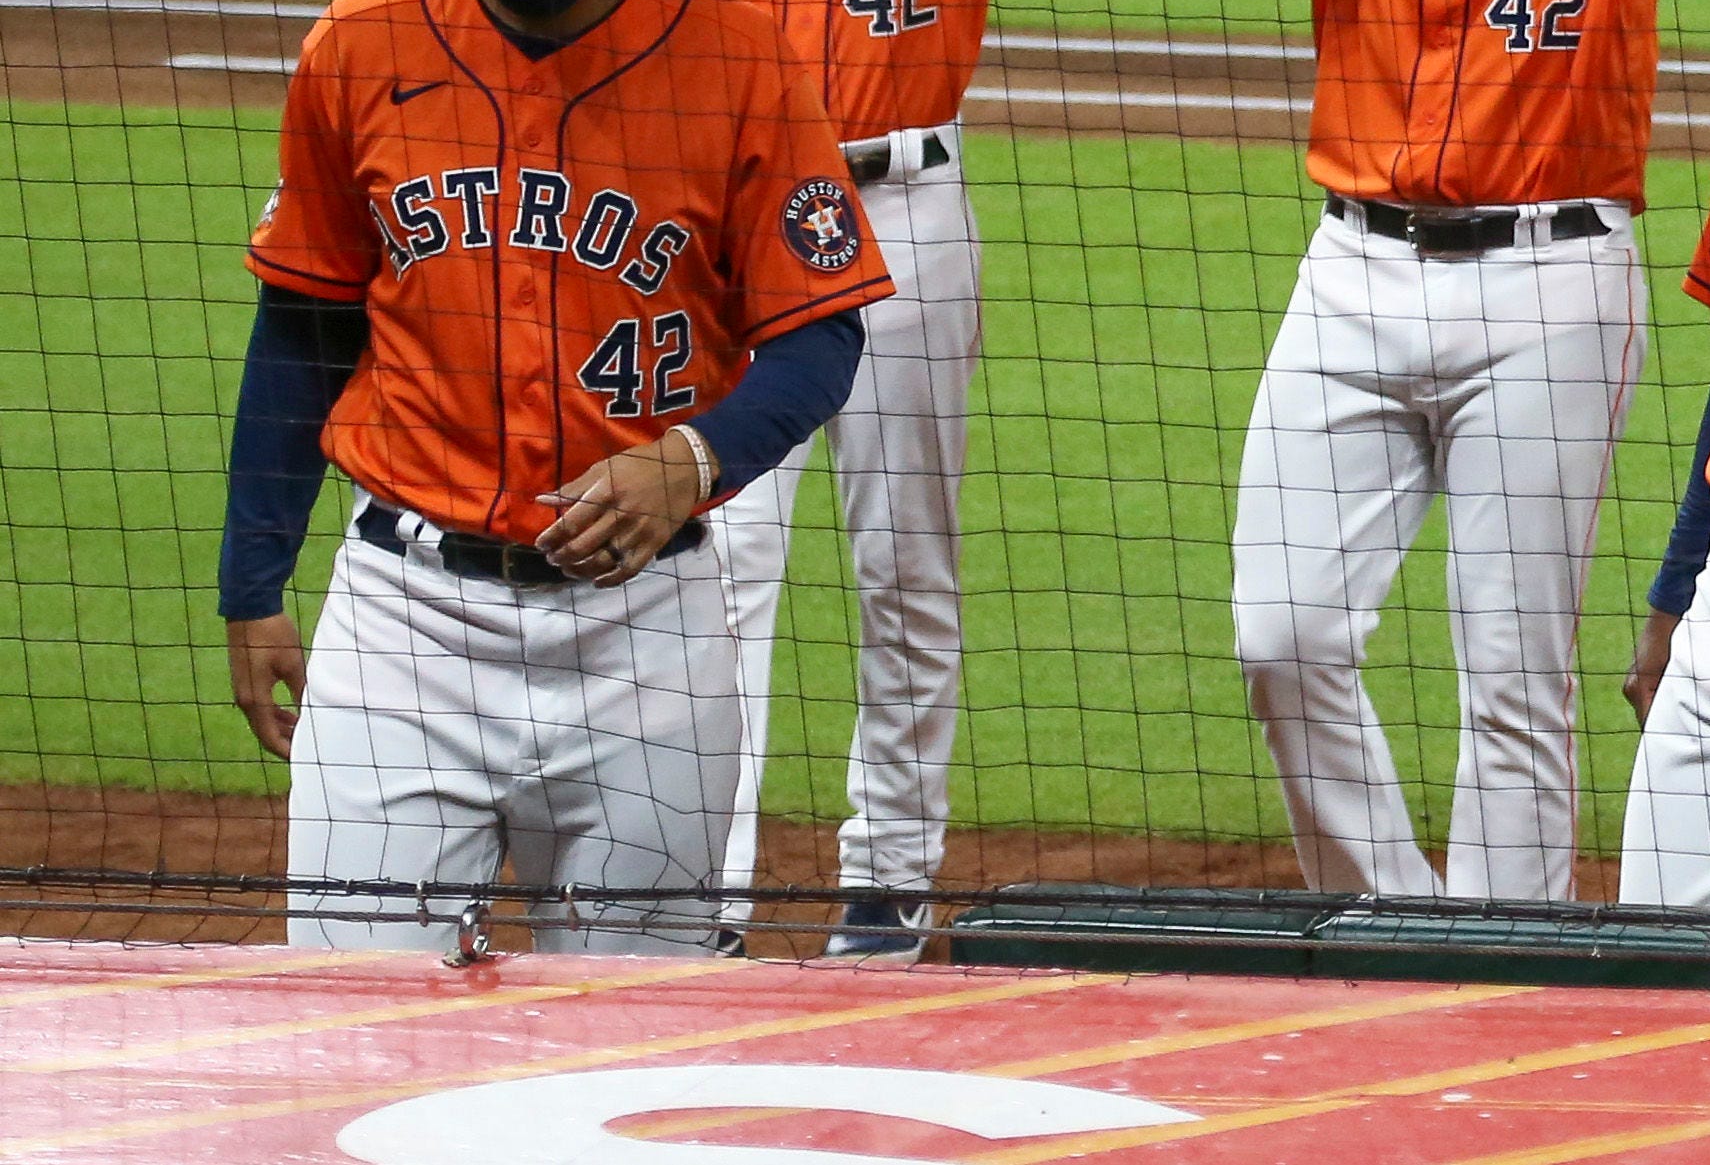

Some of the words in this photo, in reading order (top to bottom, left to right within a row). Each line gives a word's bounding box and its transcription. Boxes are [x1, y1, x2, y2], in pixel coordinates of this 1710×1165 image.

[786, 181, 844, 220] HOUSTON
[810, 236, 858, 267] ASTROS
[577, 310, 695, 419] 42
